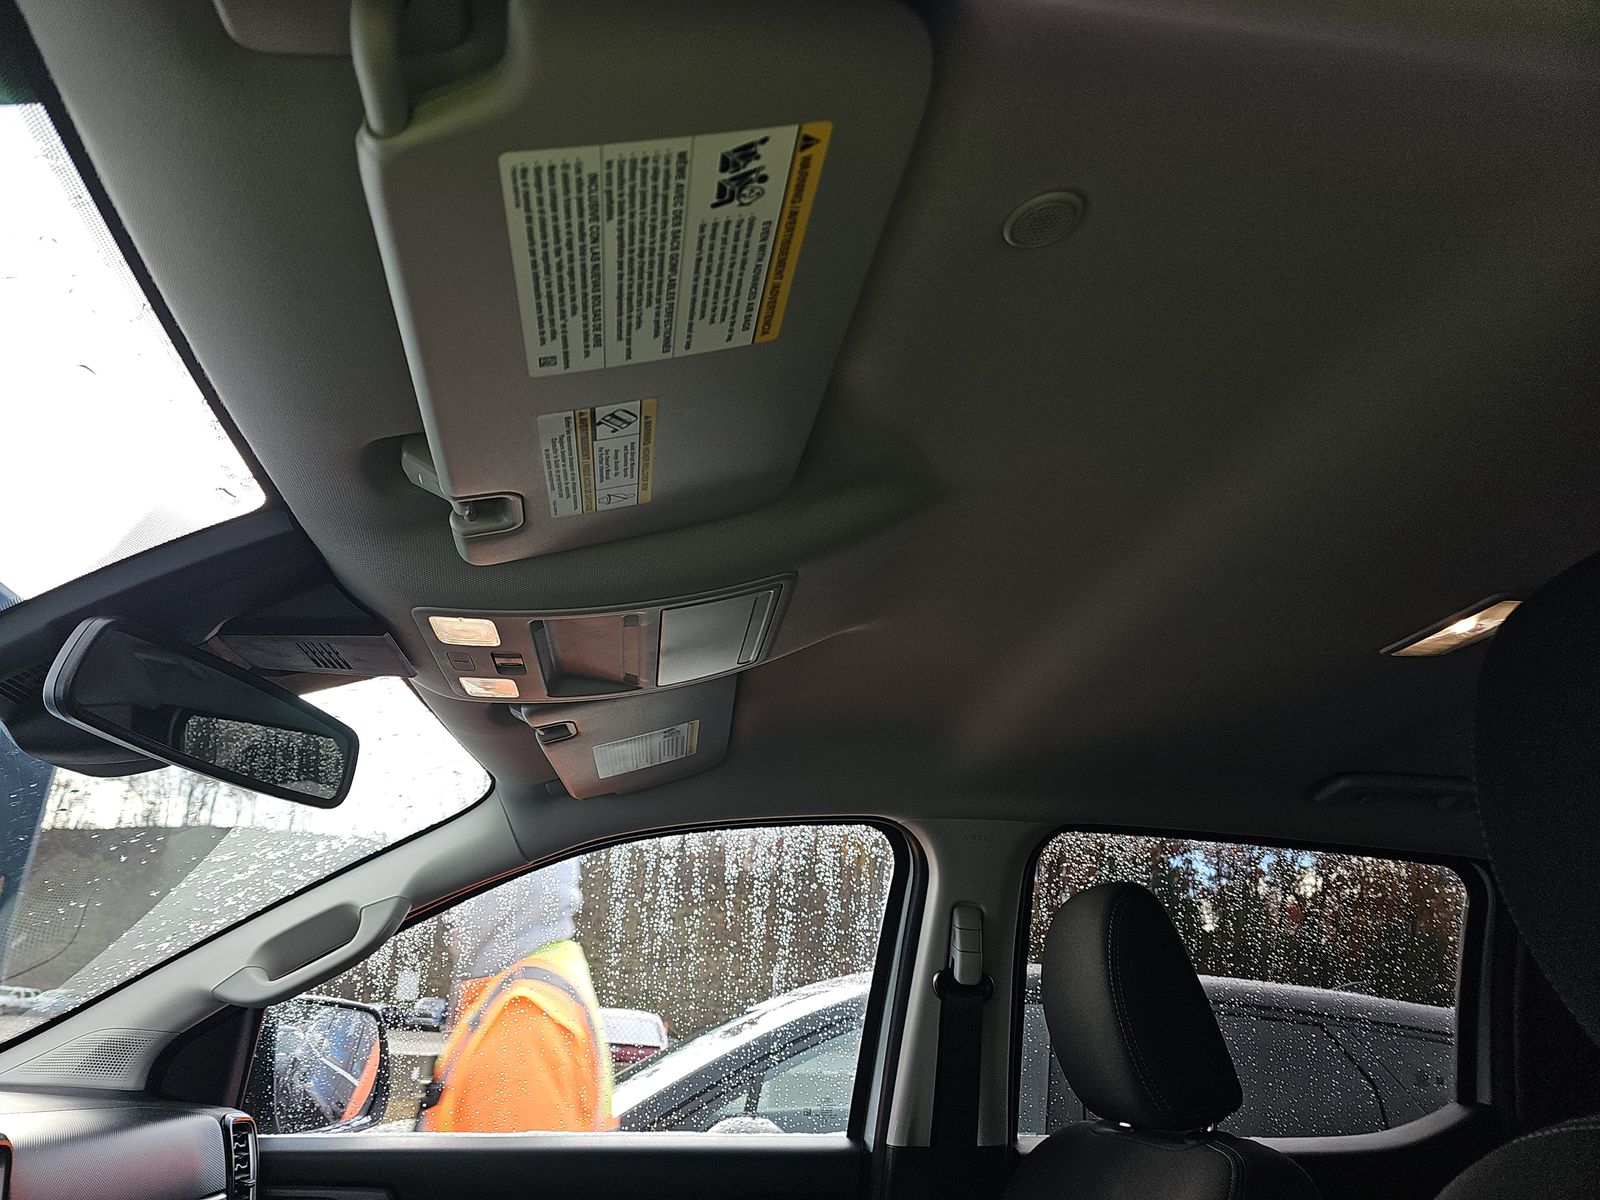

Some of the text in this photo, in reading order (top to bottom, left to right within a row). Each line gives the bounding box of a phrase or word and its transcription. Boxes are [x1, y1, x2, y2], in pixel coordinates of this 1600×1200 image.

[790, 154, 813, 204] WARNING
[587, 173, 598, 223] INCLUSIVE
[673, 182, 684, 208] AVEC
[670, 228, 680, 251] SACS
[758, 220, 772, 241] EVEN
[755, 243, 767, 262] WITH
[590, 263, 600, 293] NUEVAS
[747, 263, 762, 300] ADVANCED
[591, 294, 601, 322] BOLSAS
[741, 313, 752, 331] BAGS
[592, 333, 602, 348] AIRE
